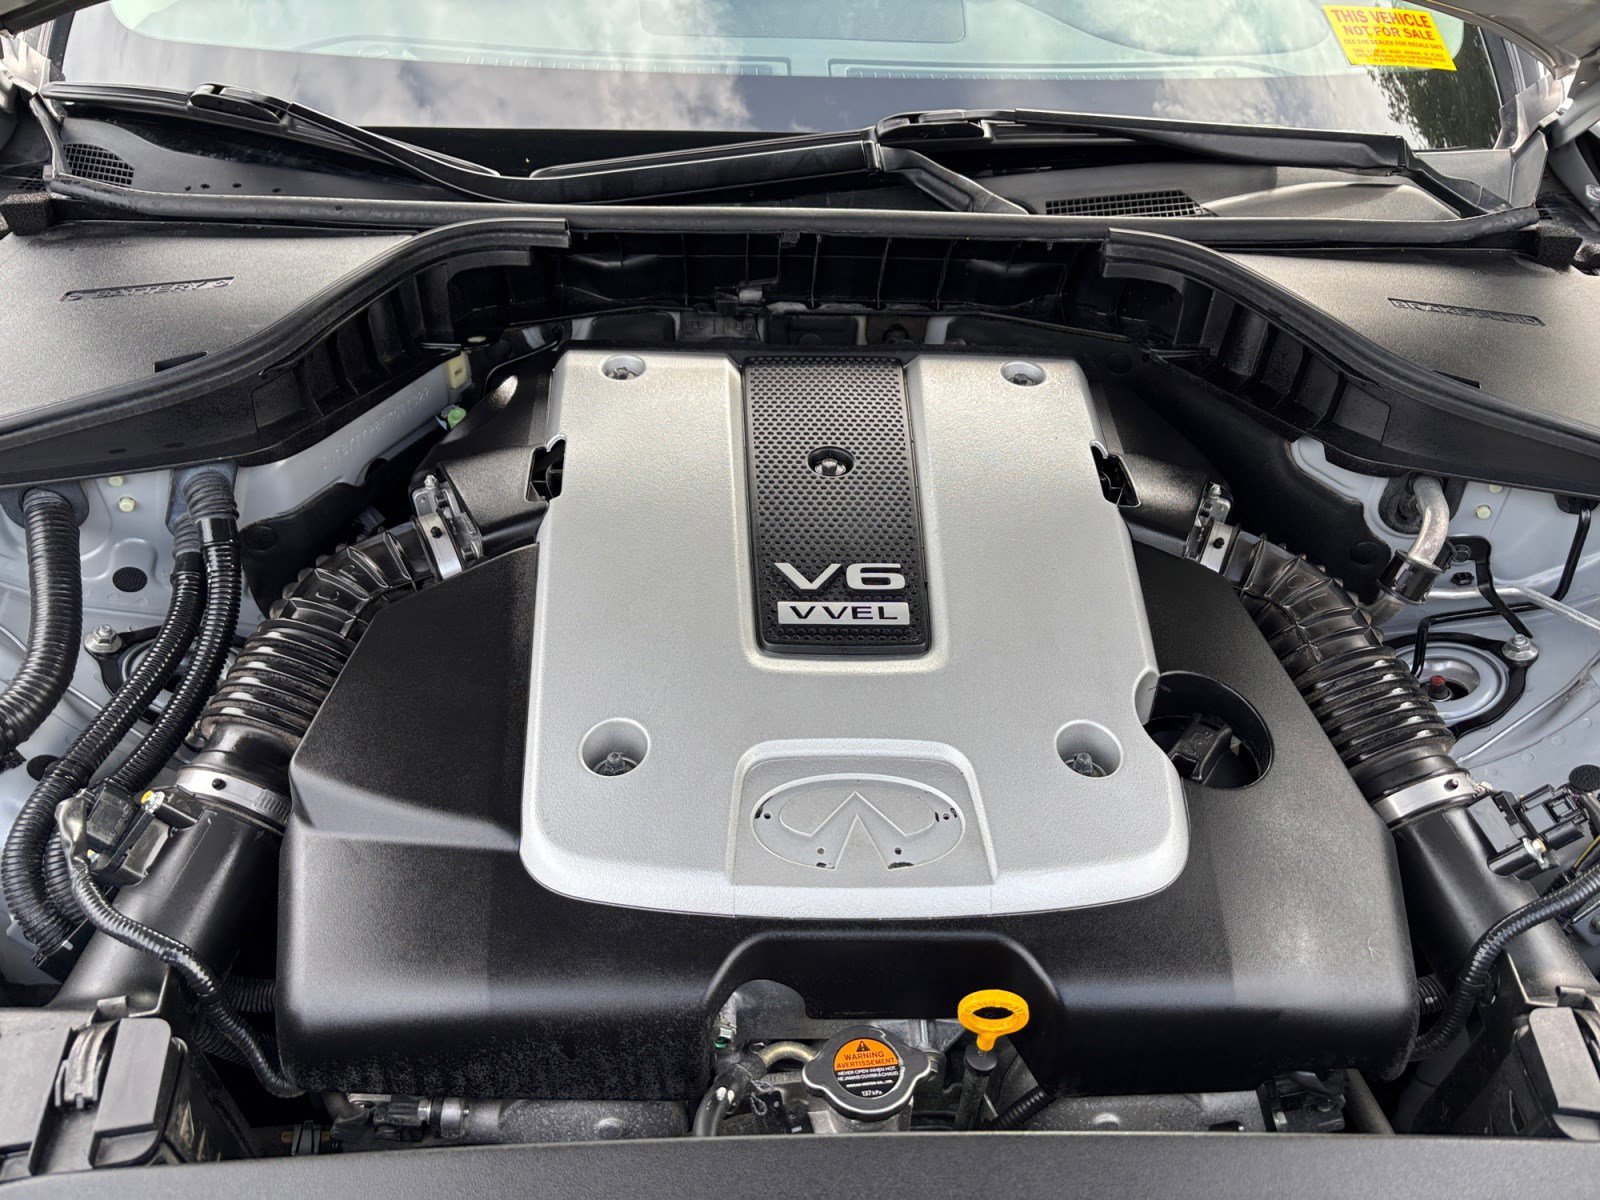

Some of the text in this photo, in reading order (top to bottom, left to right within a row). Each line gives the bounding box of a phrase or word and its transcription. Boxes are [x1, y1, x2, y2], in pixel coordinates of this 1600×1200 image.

[1330, 9, 1432, 28] THIS VEHICLE
[1343, 25, 1435, 40] NOT FOR SALE
[92, 281, 207, 299] BATTERY
[1390, 299, 1541, 326] BRAKE FLUID
[774, 562, 906, 590] V6
[789, 605, 898, 620] VVEL
[837, 1058, 895, 1069] AVERTISSEMENT
[844, 1051, 884, 1060] WARNING
